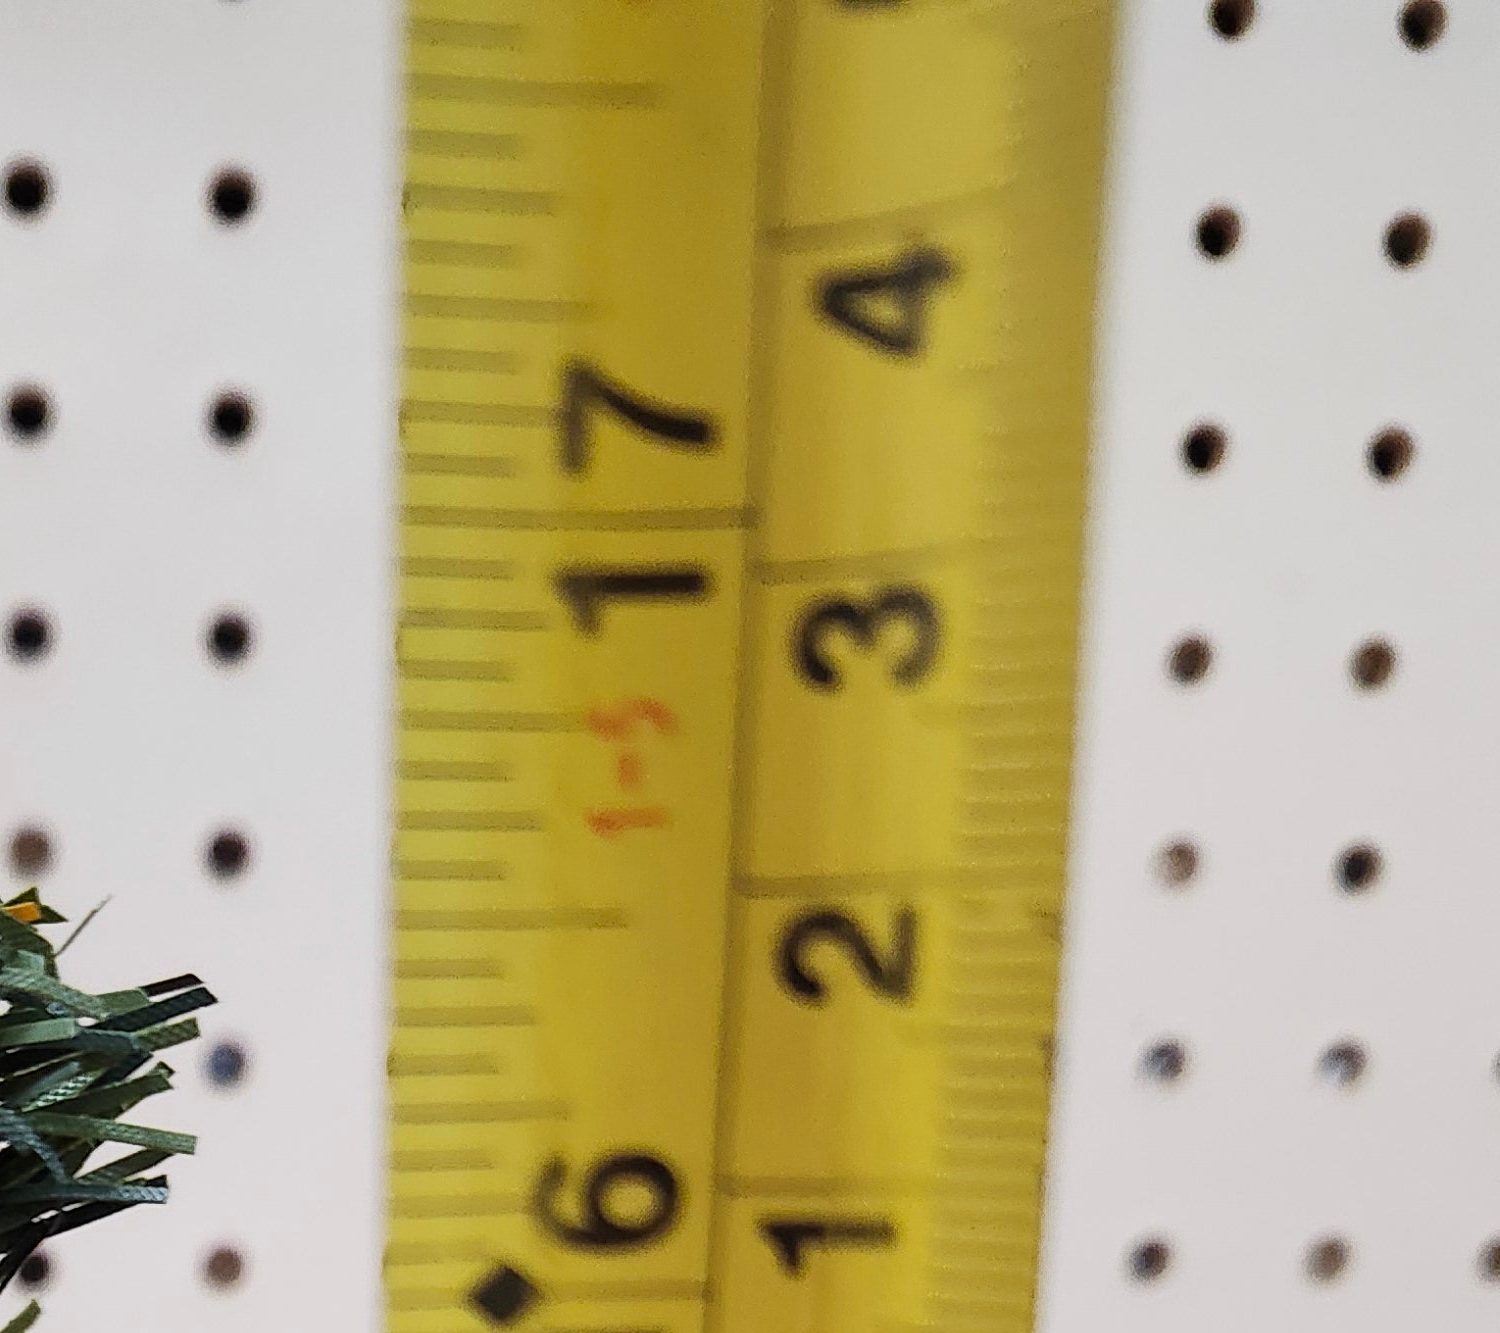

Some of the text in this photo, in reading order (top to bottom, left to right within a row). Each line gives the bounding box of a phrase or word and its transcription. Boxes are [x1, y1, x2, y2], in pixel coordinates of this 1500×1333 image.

[812, 245, 958, 360] 4
[550, 357, 722, 640] 17
[790, 583, 940, 690] 3
[775, 903, 920, 1008] 2
[756, 1215, 900, 1278] 1
